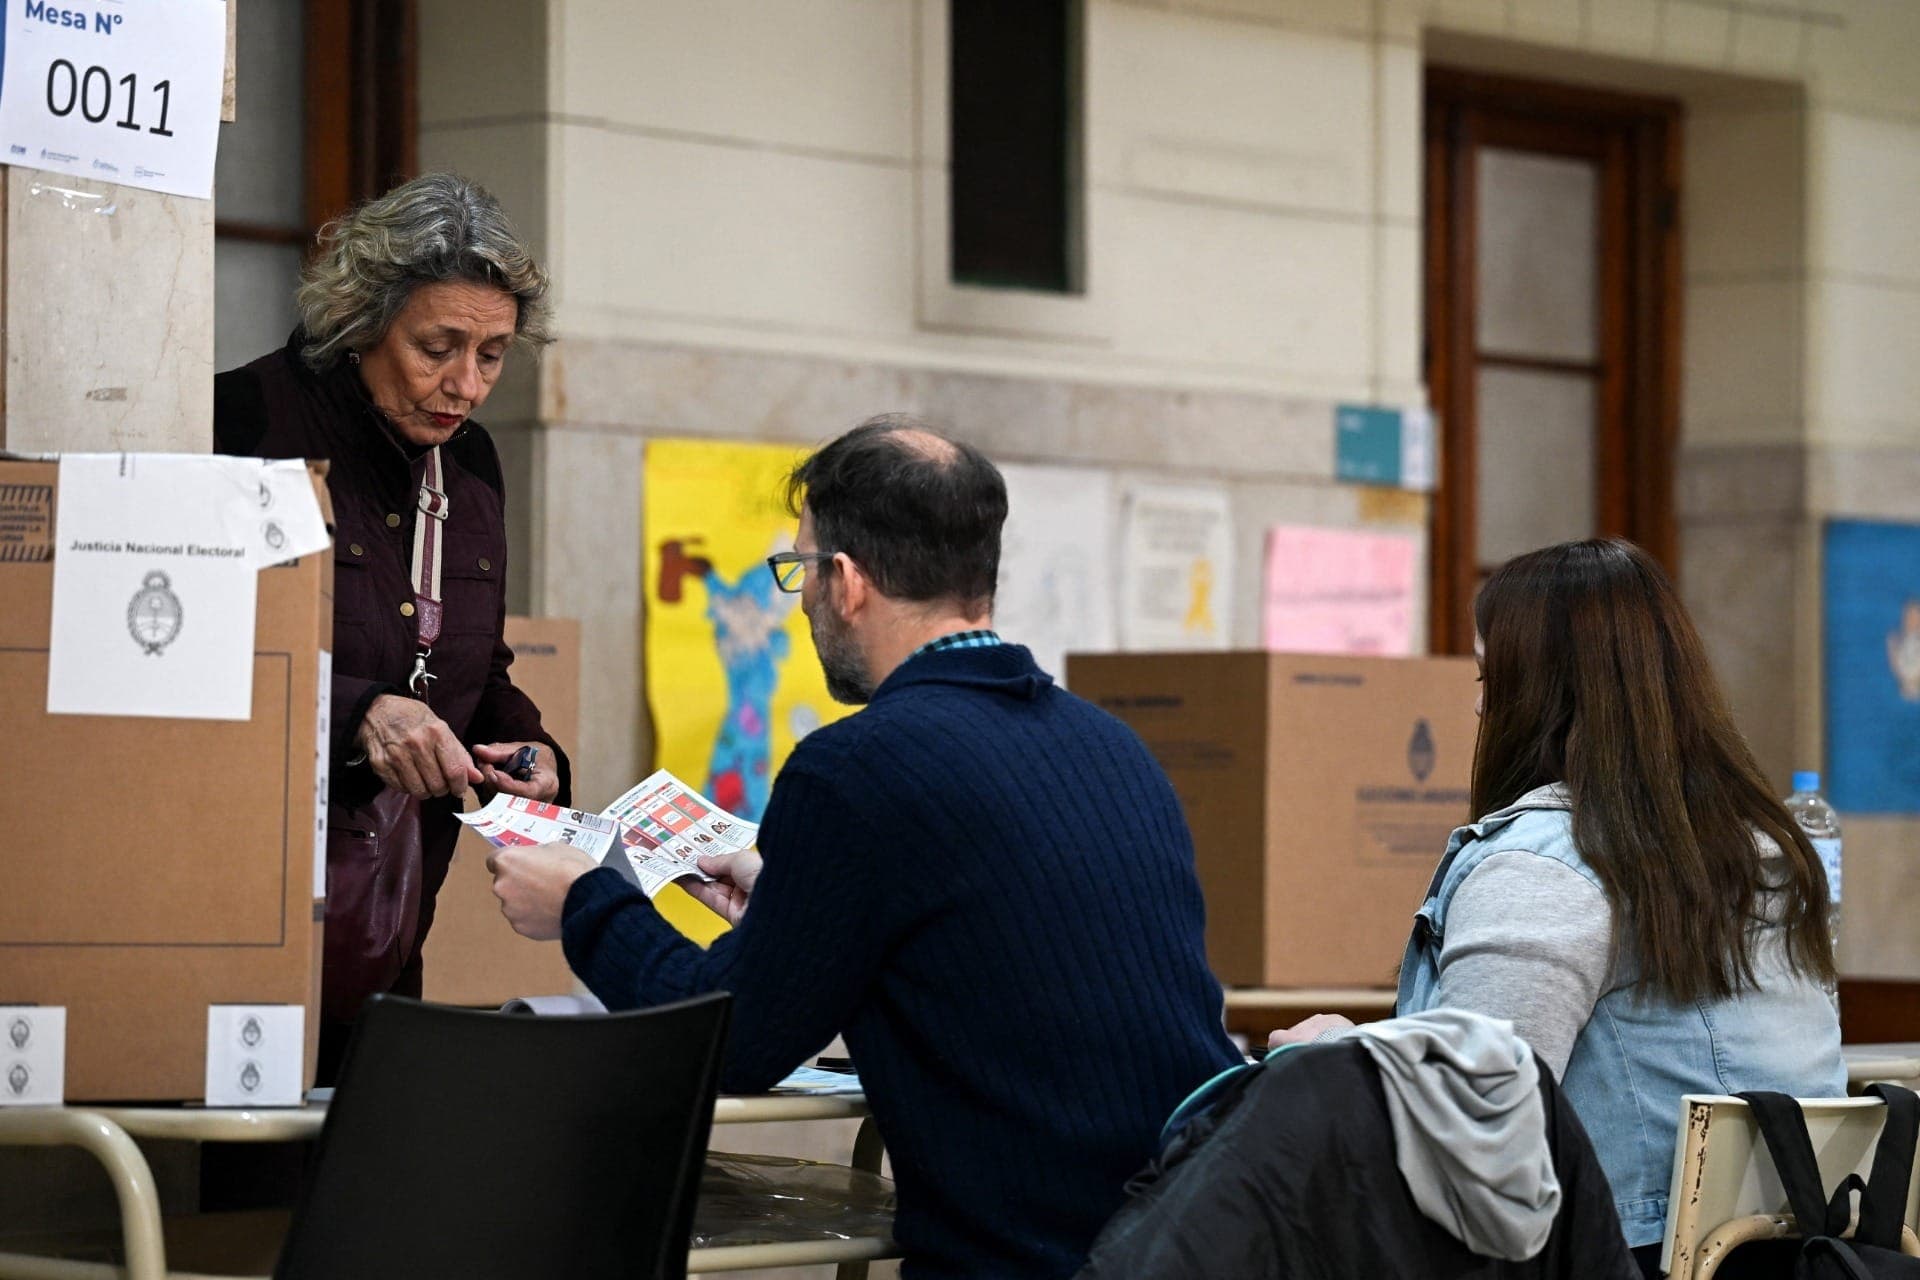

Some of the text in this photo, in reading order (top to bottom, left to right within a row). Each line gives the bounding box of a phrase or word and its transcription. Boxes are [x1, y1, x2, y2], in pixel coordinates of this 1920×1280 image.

[25, 0, 87, 30] Mesa
[46, 58, 174, 137] 0011
[70, 540, 246, 558] Justicia Nacional Electoral
